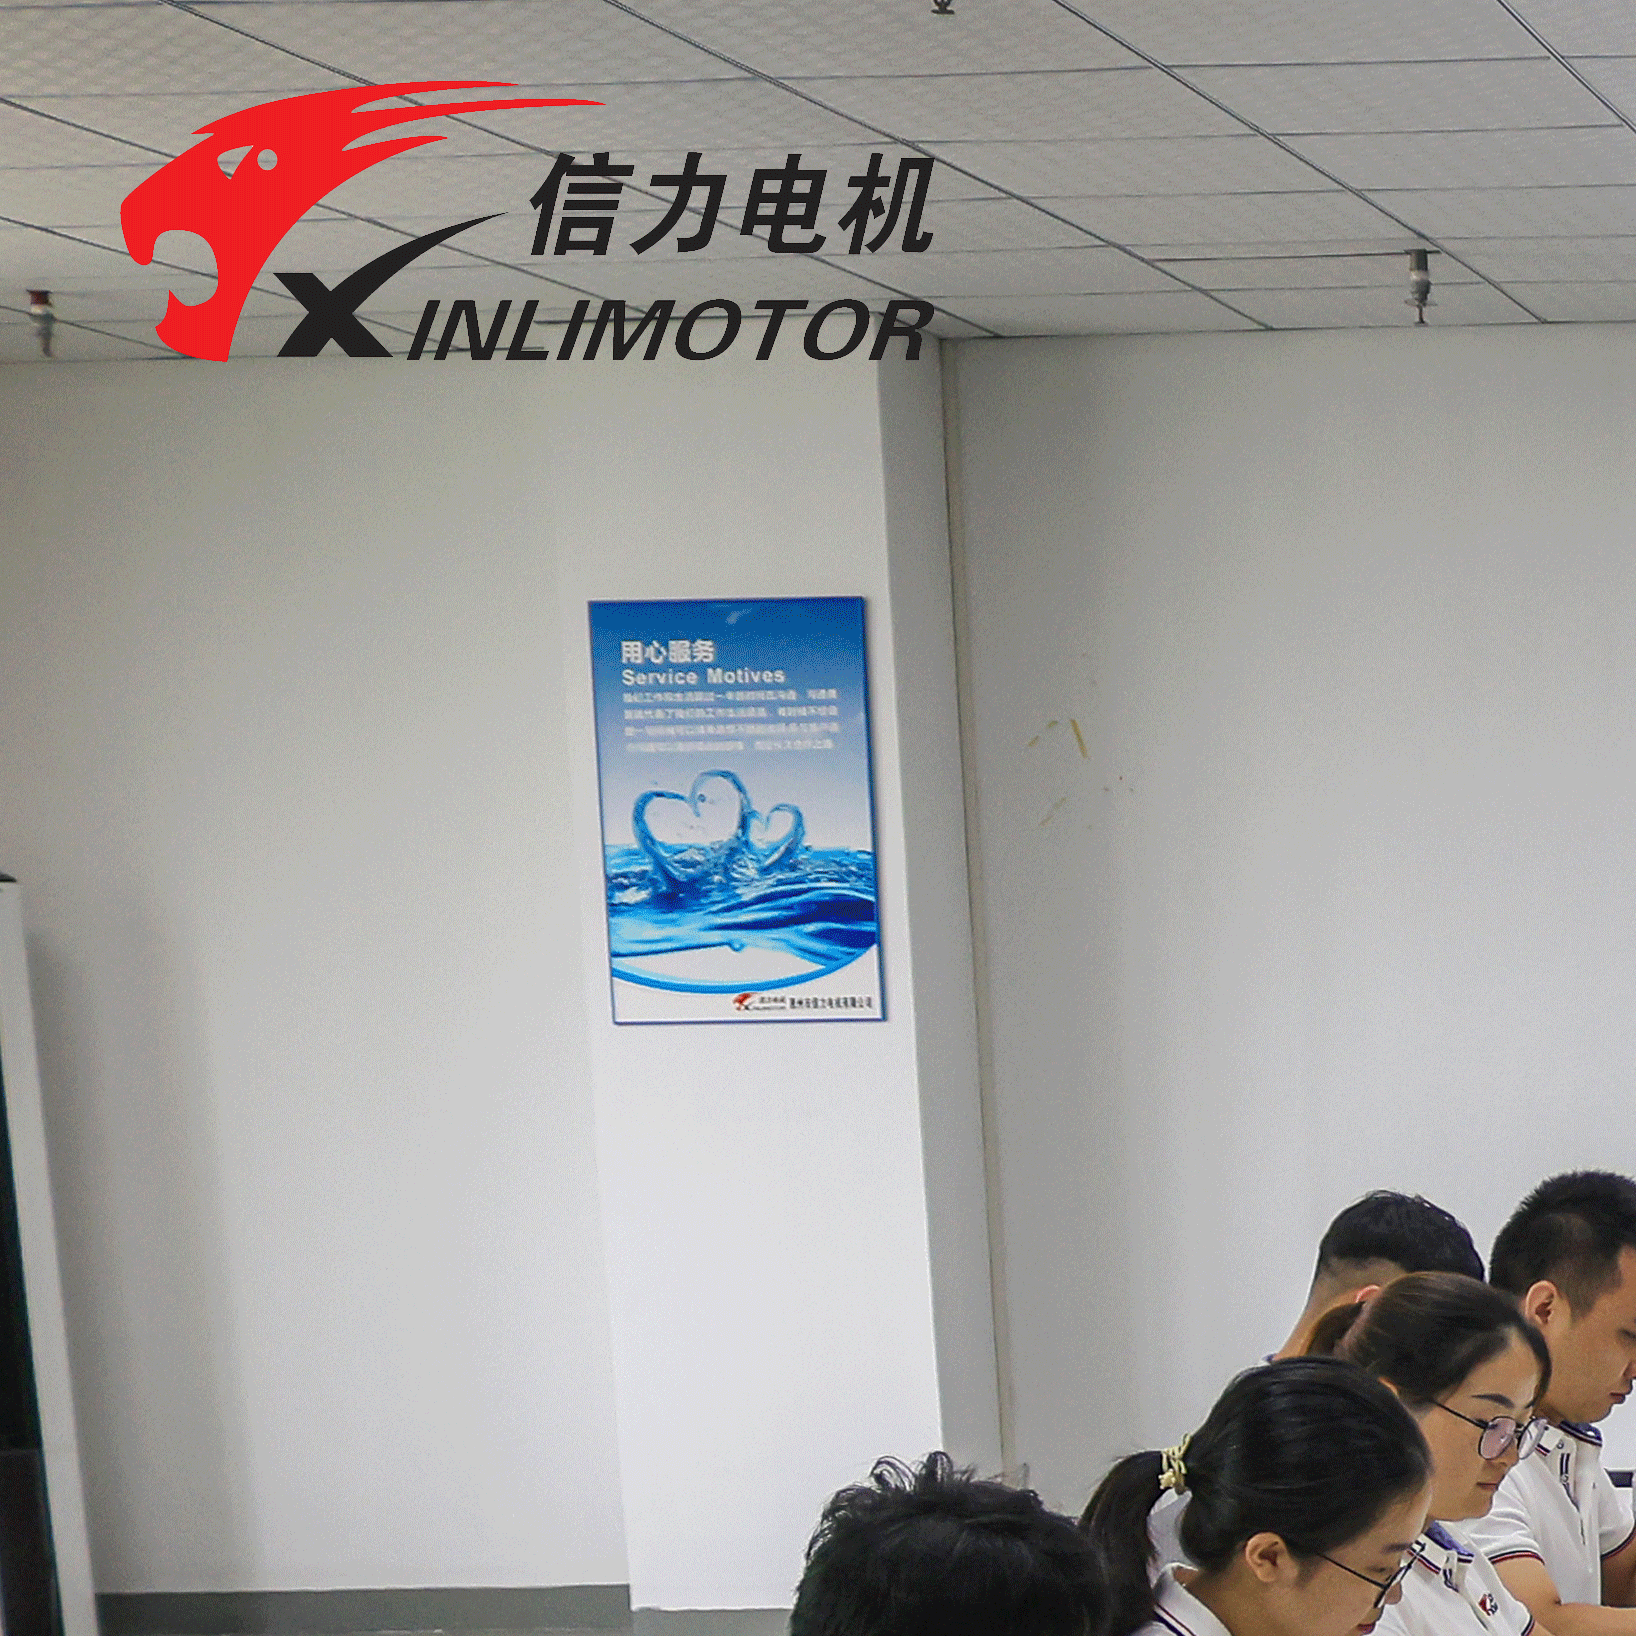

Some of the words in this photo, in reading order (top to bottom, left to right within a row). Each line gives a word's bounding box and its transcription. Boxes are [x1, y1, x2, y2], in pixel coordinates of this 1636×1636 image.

[621, 639, 715, 664] 用心服务
[622, 669, 698, 686] Service
[706, 667, 787, 684] Motives
